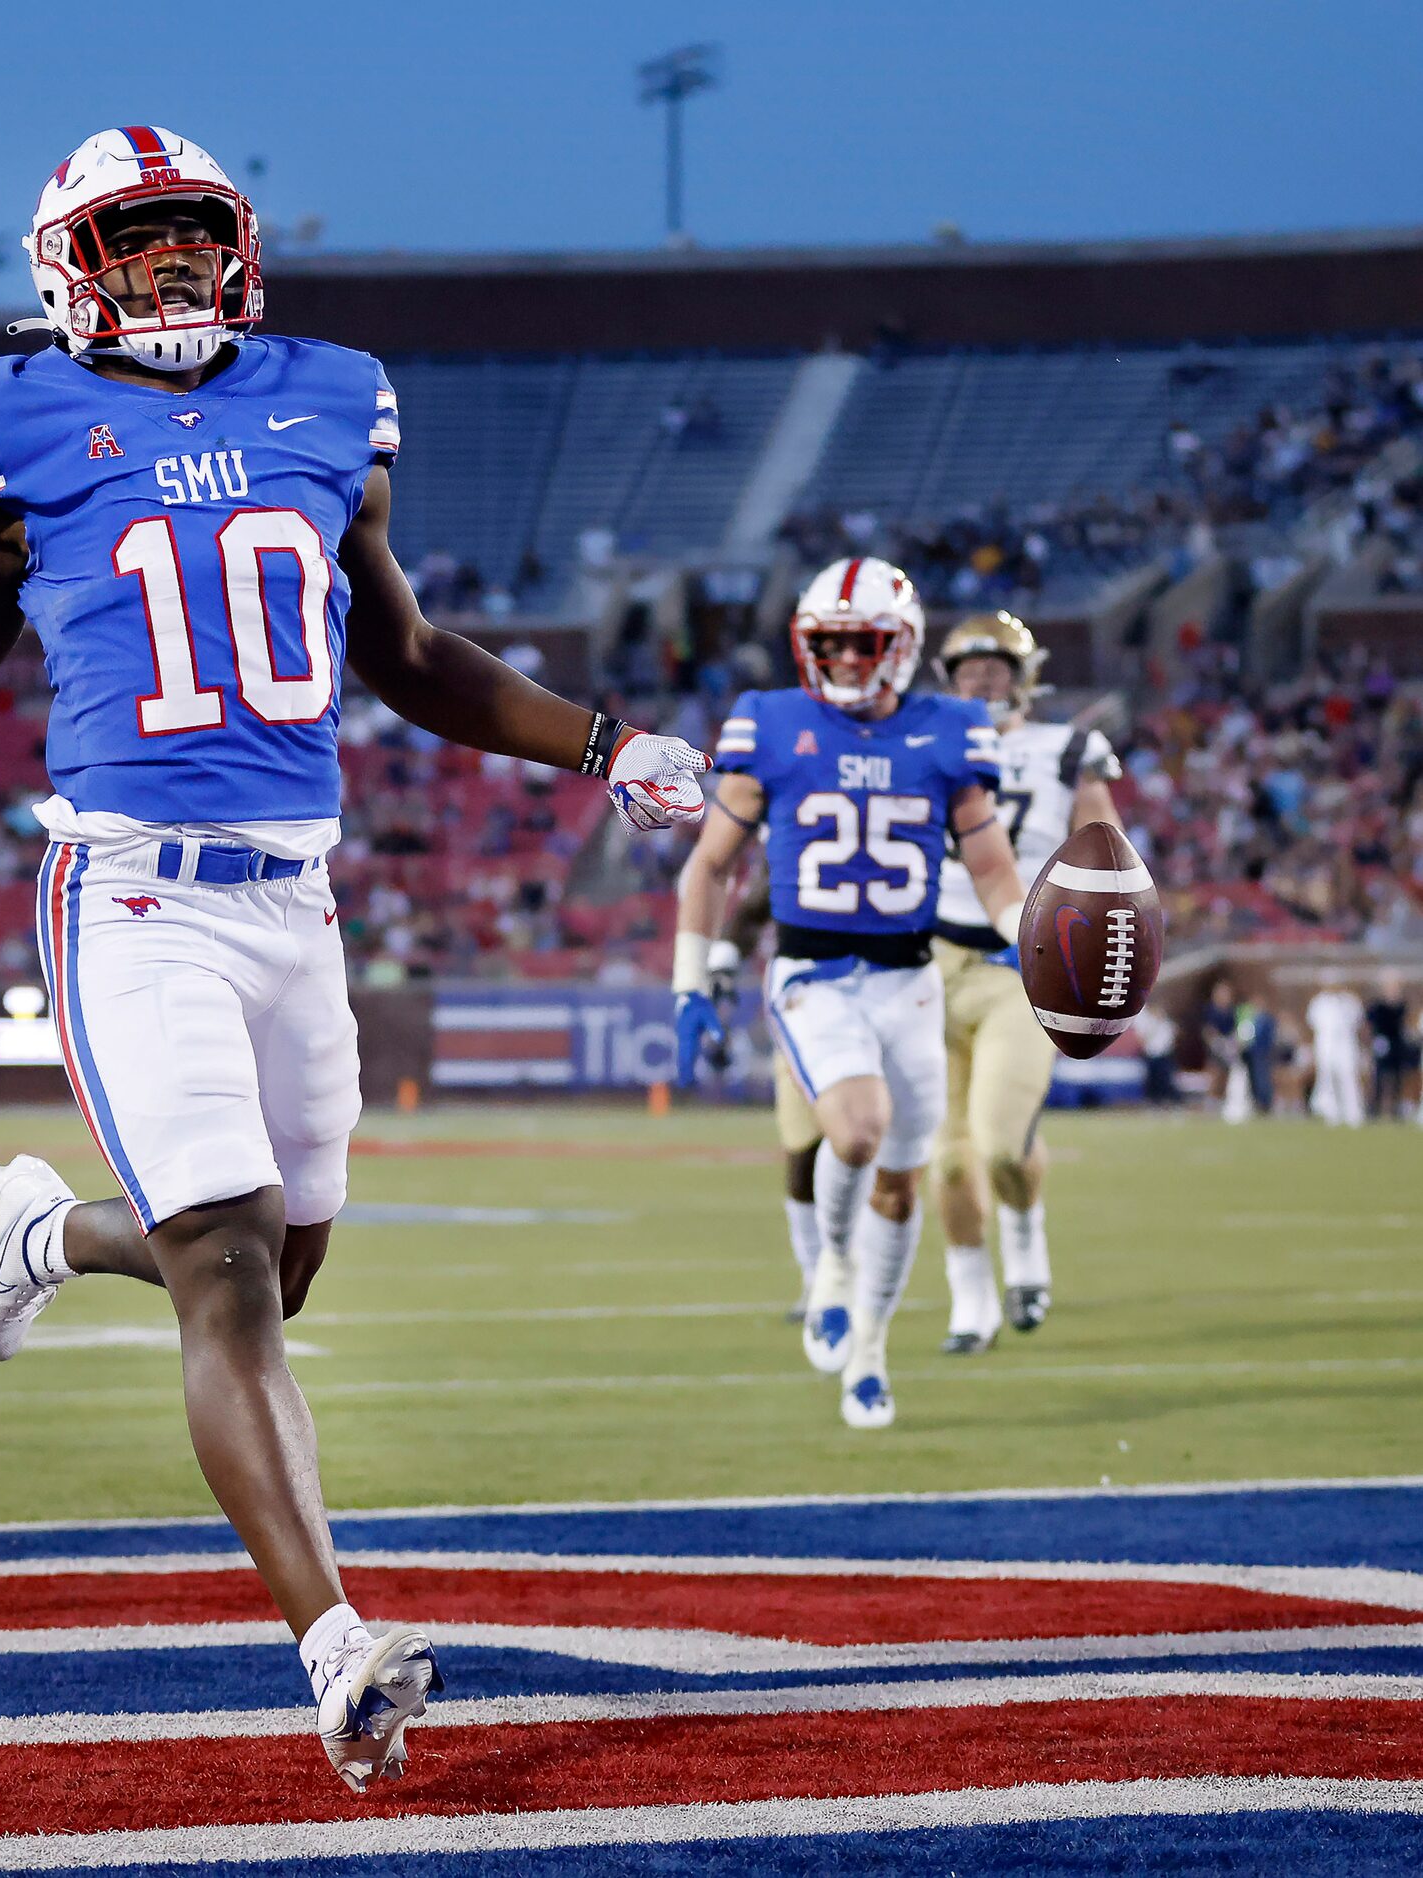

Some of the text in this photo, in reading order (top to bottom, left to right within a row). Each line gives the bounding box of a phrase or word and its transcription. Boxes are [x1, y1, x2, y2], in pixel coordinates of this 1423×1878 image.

[140, 168, 181, 184] SMU
[154, 449, 249, 505] SMU
[110, 507, 333, 738] 10
[838, 754, 892, 790] SMU
[795, 791, 931, 915] 25
